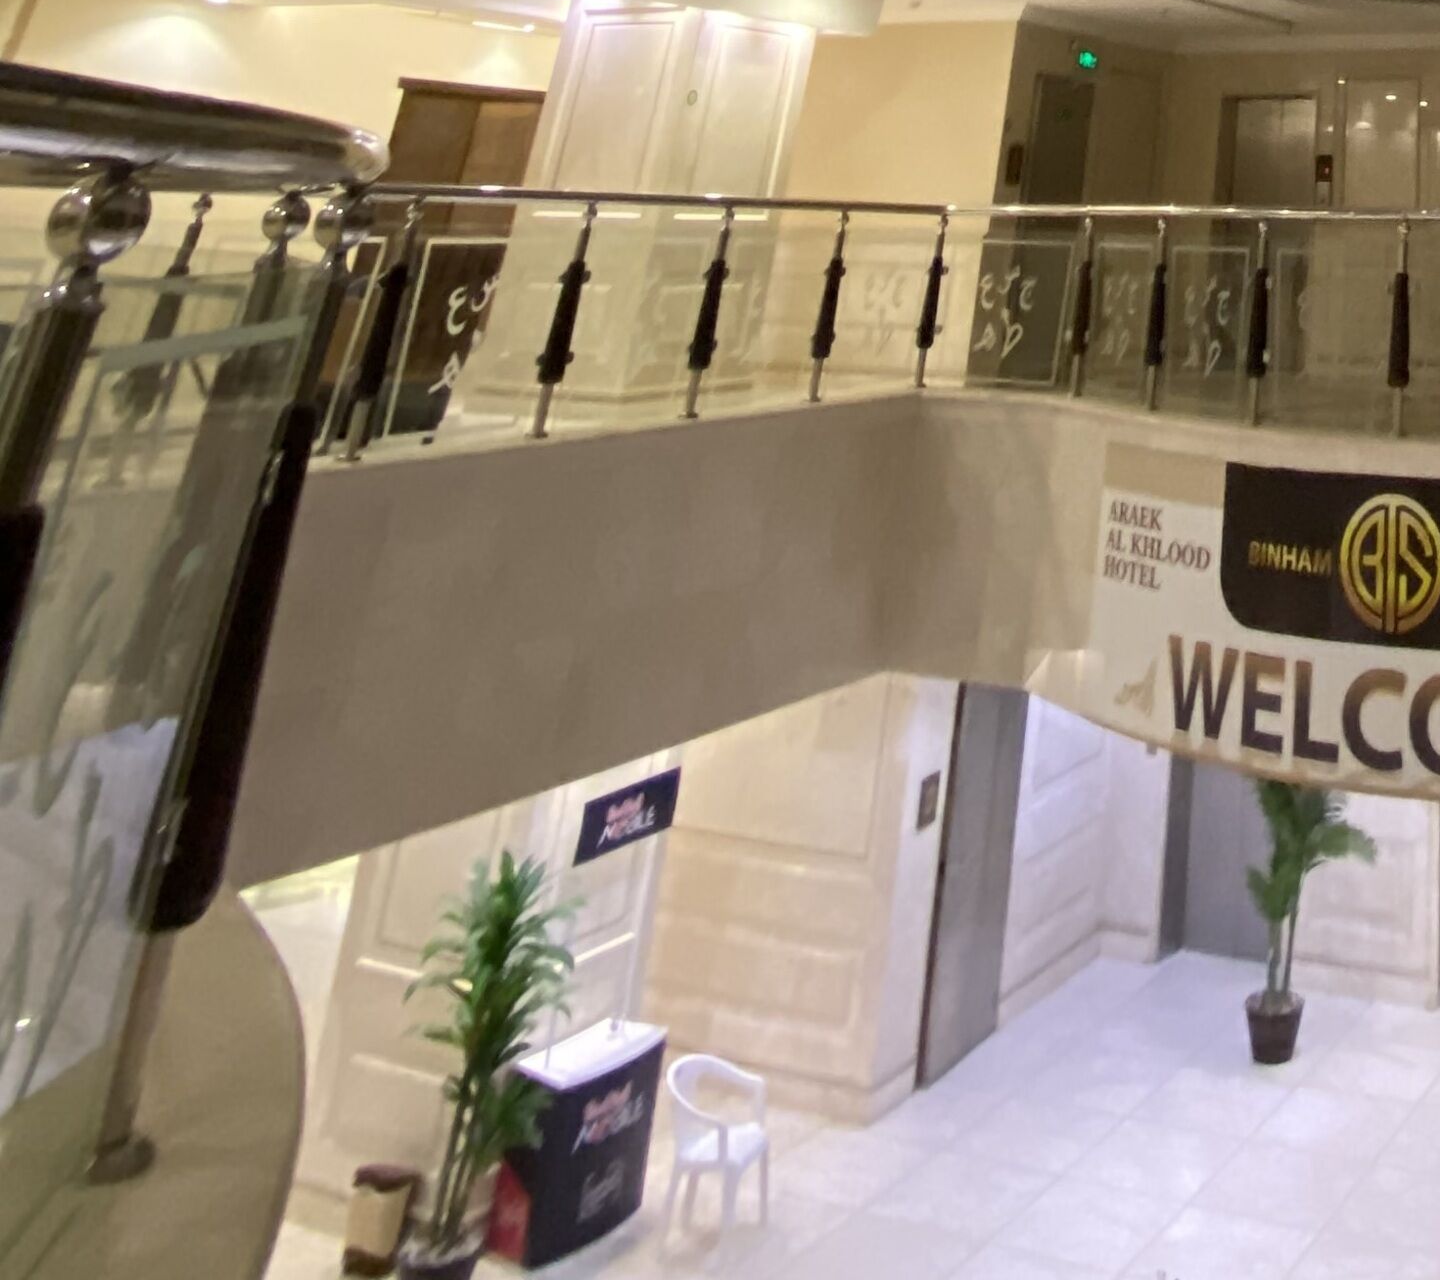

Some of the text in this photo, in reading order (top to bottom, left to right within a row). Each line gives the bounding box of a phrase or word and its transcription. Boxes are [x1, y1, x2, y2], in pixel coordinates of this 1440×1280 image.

[1108, 500, 1163, 531] ARAEK
[1106, 528, 1211, 572] AL KHLOOD
[1249, 540, 1333, 576] BINHAM
[1103, 554, 1161, 591] HOTEL
